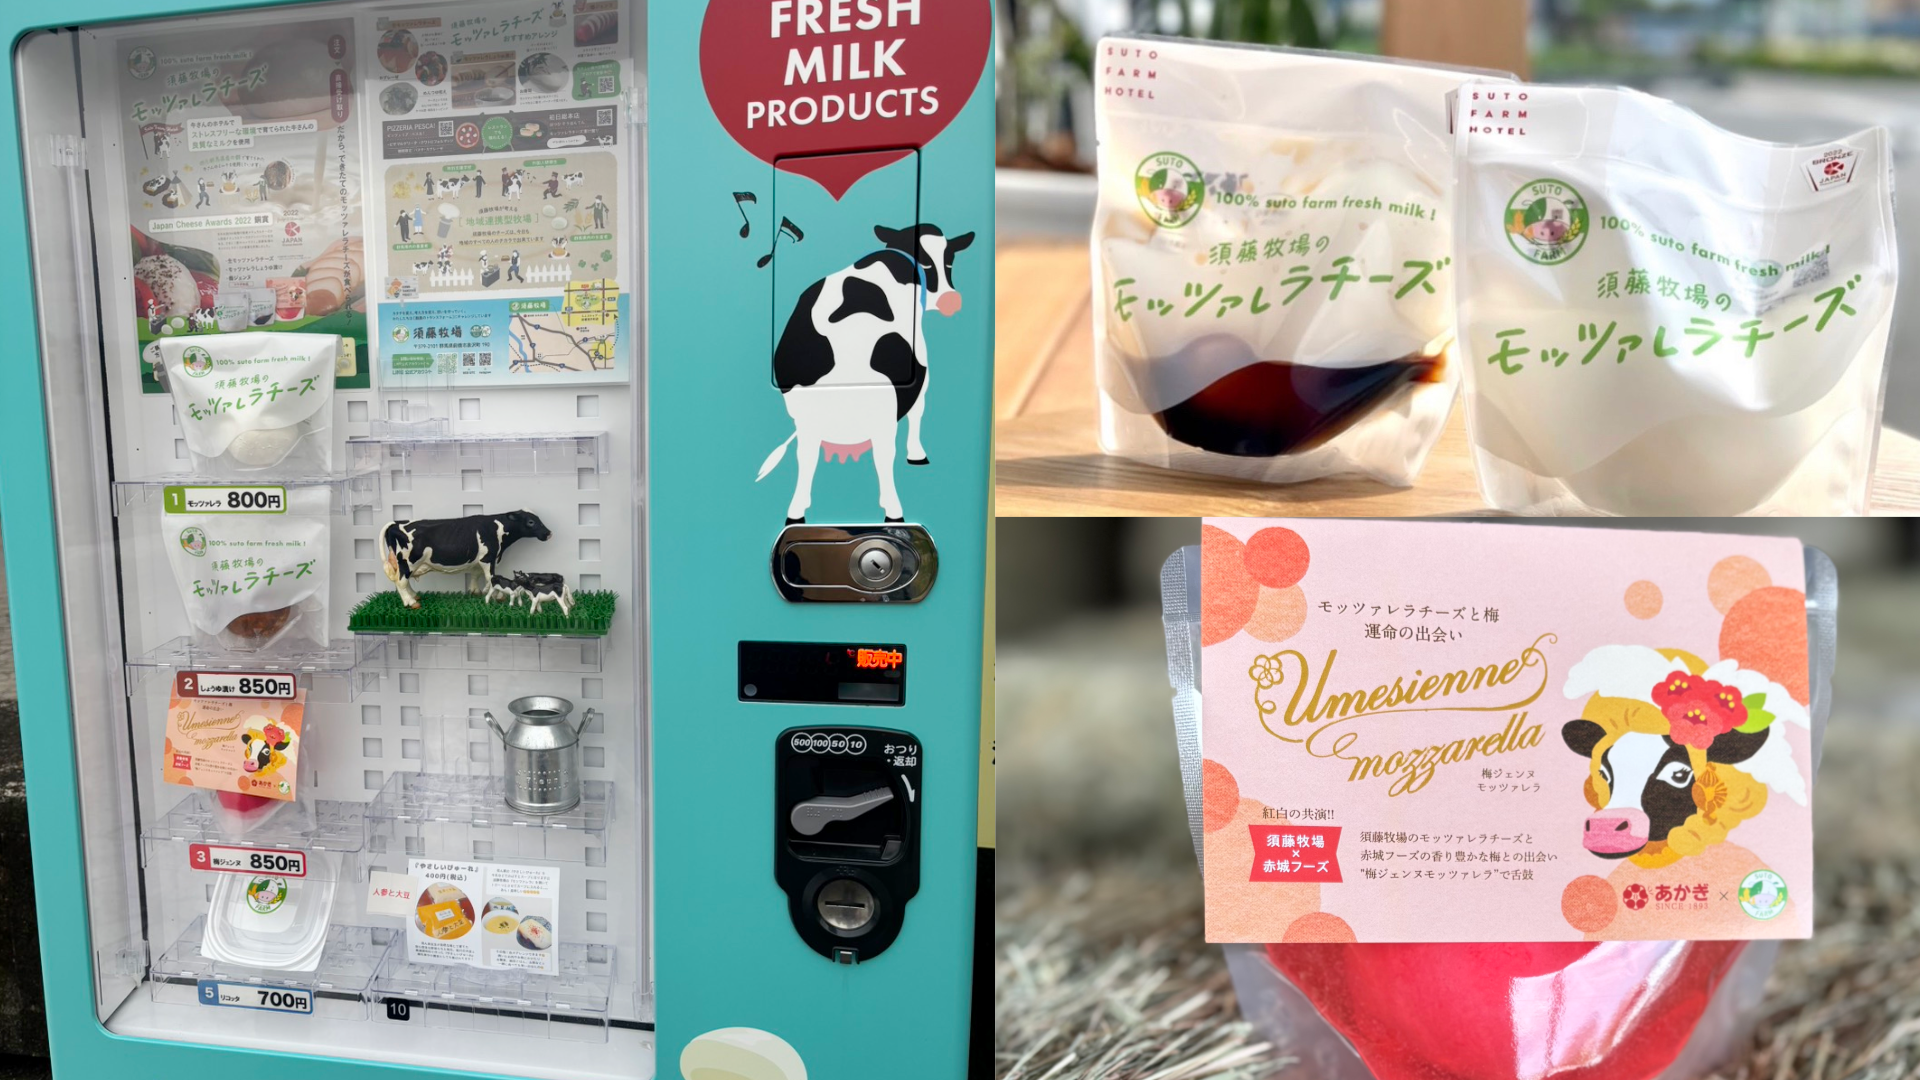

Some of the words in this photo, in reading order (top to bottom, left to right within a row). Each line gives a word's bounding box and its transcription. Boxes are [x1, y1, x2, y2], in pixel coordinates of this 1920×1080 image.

[451, 16, 487, 30] 須藤牧場の
[770, 0, 920, 38] FRESH
[450, 8, 544, 46] モッツァレラチーズ
[503, 30, 558, 42] おすすめアレンジ
[334, 39, 341, 54] 注文
[1107, 47, 1158, 60] SUTO
[784, 38, 906, 86] MILK
[166, 67, 220, 86] 須藤牧場の
[1106, 66, 1156, 79] FARM
[131, 64, 268, 122] モッツァレラチーズ
[1104, 86, 1154, 100] HOTEL
[1472, 92, 1528, 101] SUTO
[746, 86, 939, 129] PRODUCTS
[1470, 110, 1527, 118] FARM
[386, 124, 414, 132] PIZZERIA
[1469, 126, 1526, 136] HOTEL
[1812, 150, 1854, 166] BRONZE
[1824, 149, 1843, 158] 2022
[1156, 157, 1184, 168] SUTO
[1819, 172, 1847, 184] JAPAN
[1532, 184, 1562, 196] SUTO
[1216, 192, 1260, 208] 100%
[1265, 198, 1297, 208] suto
[1302, 196, 1338, 209] farm
[1342, 195, 1383, 210] fresh
[1388, 201, 1425, 220] milk
[152, 222, 174, 230] Japan
[176, 219, 203, 228] Cheese
[206, 218, 233, 227] Awards
[235, 216, 252, 225] 2022
[254, 214, 270, 224] 銅賞
[1208, 233, 1330, 266] 須藤牧場の
[1533, 246, 1568, 260] FARM
[1600, 216, 1645, 238] 100%
[1650, 233, 1686, 252] suto
[1691, 242, 1731, 266] farm
[1734, 259, 1779, 278] fresh
[1785, 252, 1821, 272] milk
[1114, 256, 1452, 322] モッツァレラチーズ
[1597, 268, 1732, 312] 須藤牧場の
[1487, 273, 1862, 375] モッツァレラチーズ
[412, 325, 463, 340] 須藤牧場
[216, 358, 235, 366] 100%
[254, 356, 270, 364] farm
[214, 374, 270, 390] 須藤牧場の
[188, 374, 320, 421] モッツァレラチーズ
[172, 493, 178, 506] 1
[187, 500, 222, 508] モッツァレラ
[227, 492, 281, 509] 800円
[211, 558, 264, 572] 須藤牧場の
[192, 559, 316, 597] モッツァレラチーズ
[1318, 600, 1500, 624] モッツァレラチーズと梅
[1364, 623, 1463, 644] 運命の出会い
[857, 648, 902, 668] 販売中
[183, 678, 194, 690] 2
[239, 678, 291, 695] 850円
[1256, 643, 1545, 727] Umesienne
[180, 711, 239, 731] Umesienne
[192, 731, 238, 750] mozzarella
[794, 738, 810, 746] 500
[813, 740, 828, 748] 100
[831, 740, 845, 748] 50
[850, 740, 862, 748] 10
[884, 744, 917, 756] おつり
[1334, 711, 1546, 798] mozzarella
[1481, 768, 1536, 779] 梅ジェンヌ
[1477, 782, 1541, 793] モッツァレラ
[1262, 807, 1335, 820] 紅白の共演!!
[1266, 834, 1325, 849] 須藤牧場
[1360, 831, 1534, 845] 須藤牧場のモッツァレラチーズと
[196, 851, 206, 862] 3
[213, 858, 242, 867] 梅ジェンヌ
[250, 853, 301, 872] 850円
[1360, 850, 1558, 864] 赤城フーズの香り豊かな梅との出会い
[1262, 860, 1330, 874] 赤城フーズ
[425, 872, 468, 882] 400円(税込)
[1754, 872, 1773, 880] SUTO
[372, 888, 410, 900] 人参と大豆
[1654, 883, 1709, 902] あかぎ
[1655, 902, 1684, 910] SINCE
[1688, 902, 1709, 910] 1893
[204, 988, 214, 998] 5
[220, 994, 240, 1002] リコッタ
[258, 990, 307, 1009] 700円
[390, 1002, 406, 1016] 10
